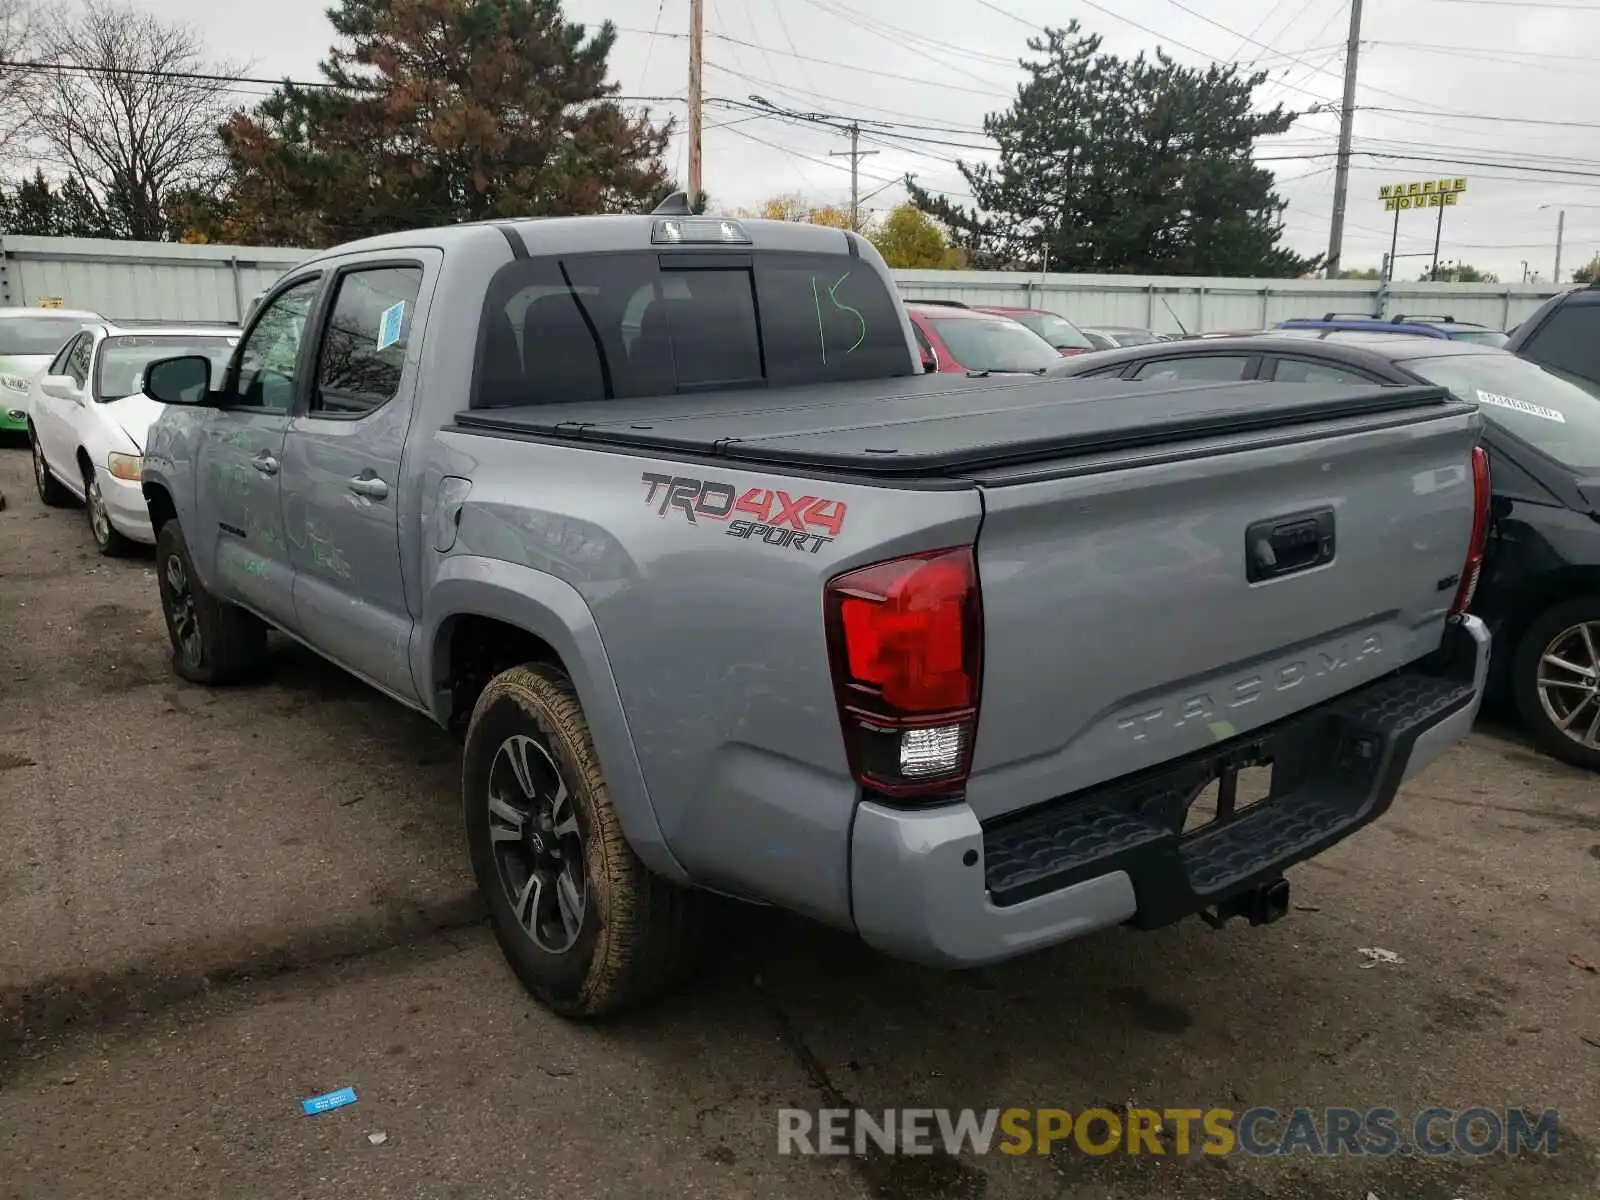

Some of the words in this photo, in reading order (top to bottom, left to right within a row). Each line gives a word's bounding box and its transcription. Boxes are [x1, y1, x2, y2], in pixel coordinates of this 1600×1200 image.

[1379, 178, 1466, 197] WAFFLE
[1386, 193, 1455, 210] HOUSE
[812, 271, 866, 365] 15
[641, 472, 736, 525] TRD
[725, 519, 835, 554] SPORT
[1117, 632, 1384, 741] TACOMA
